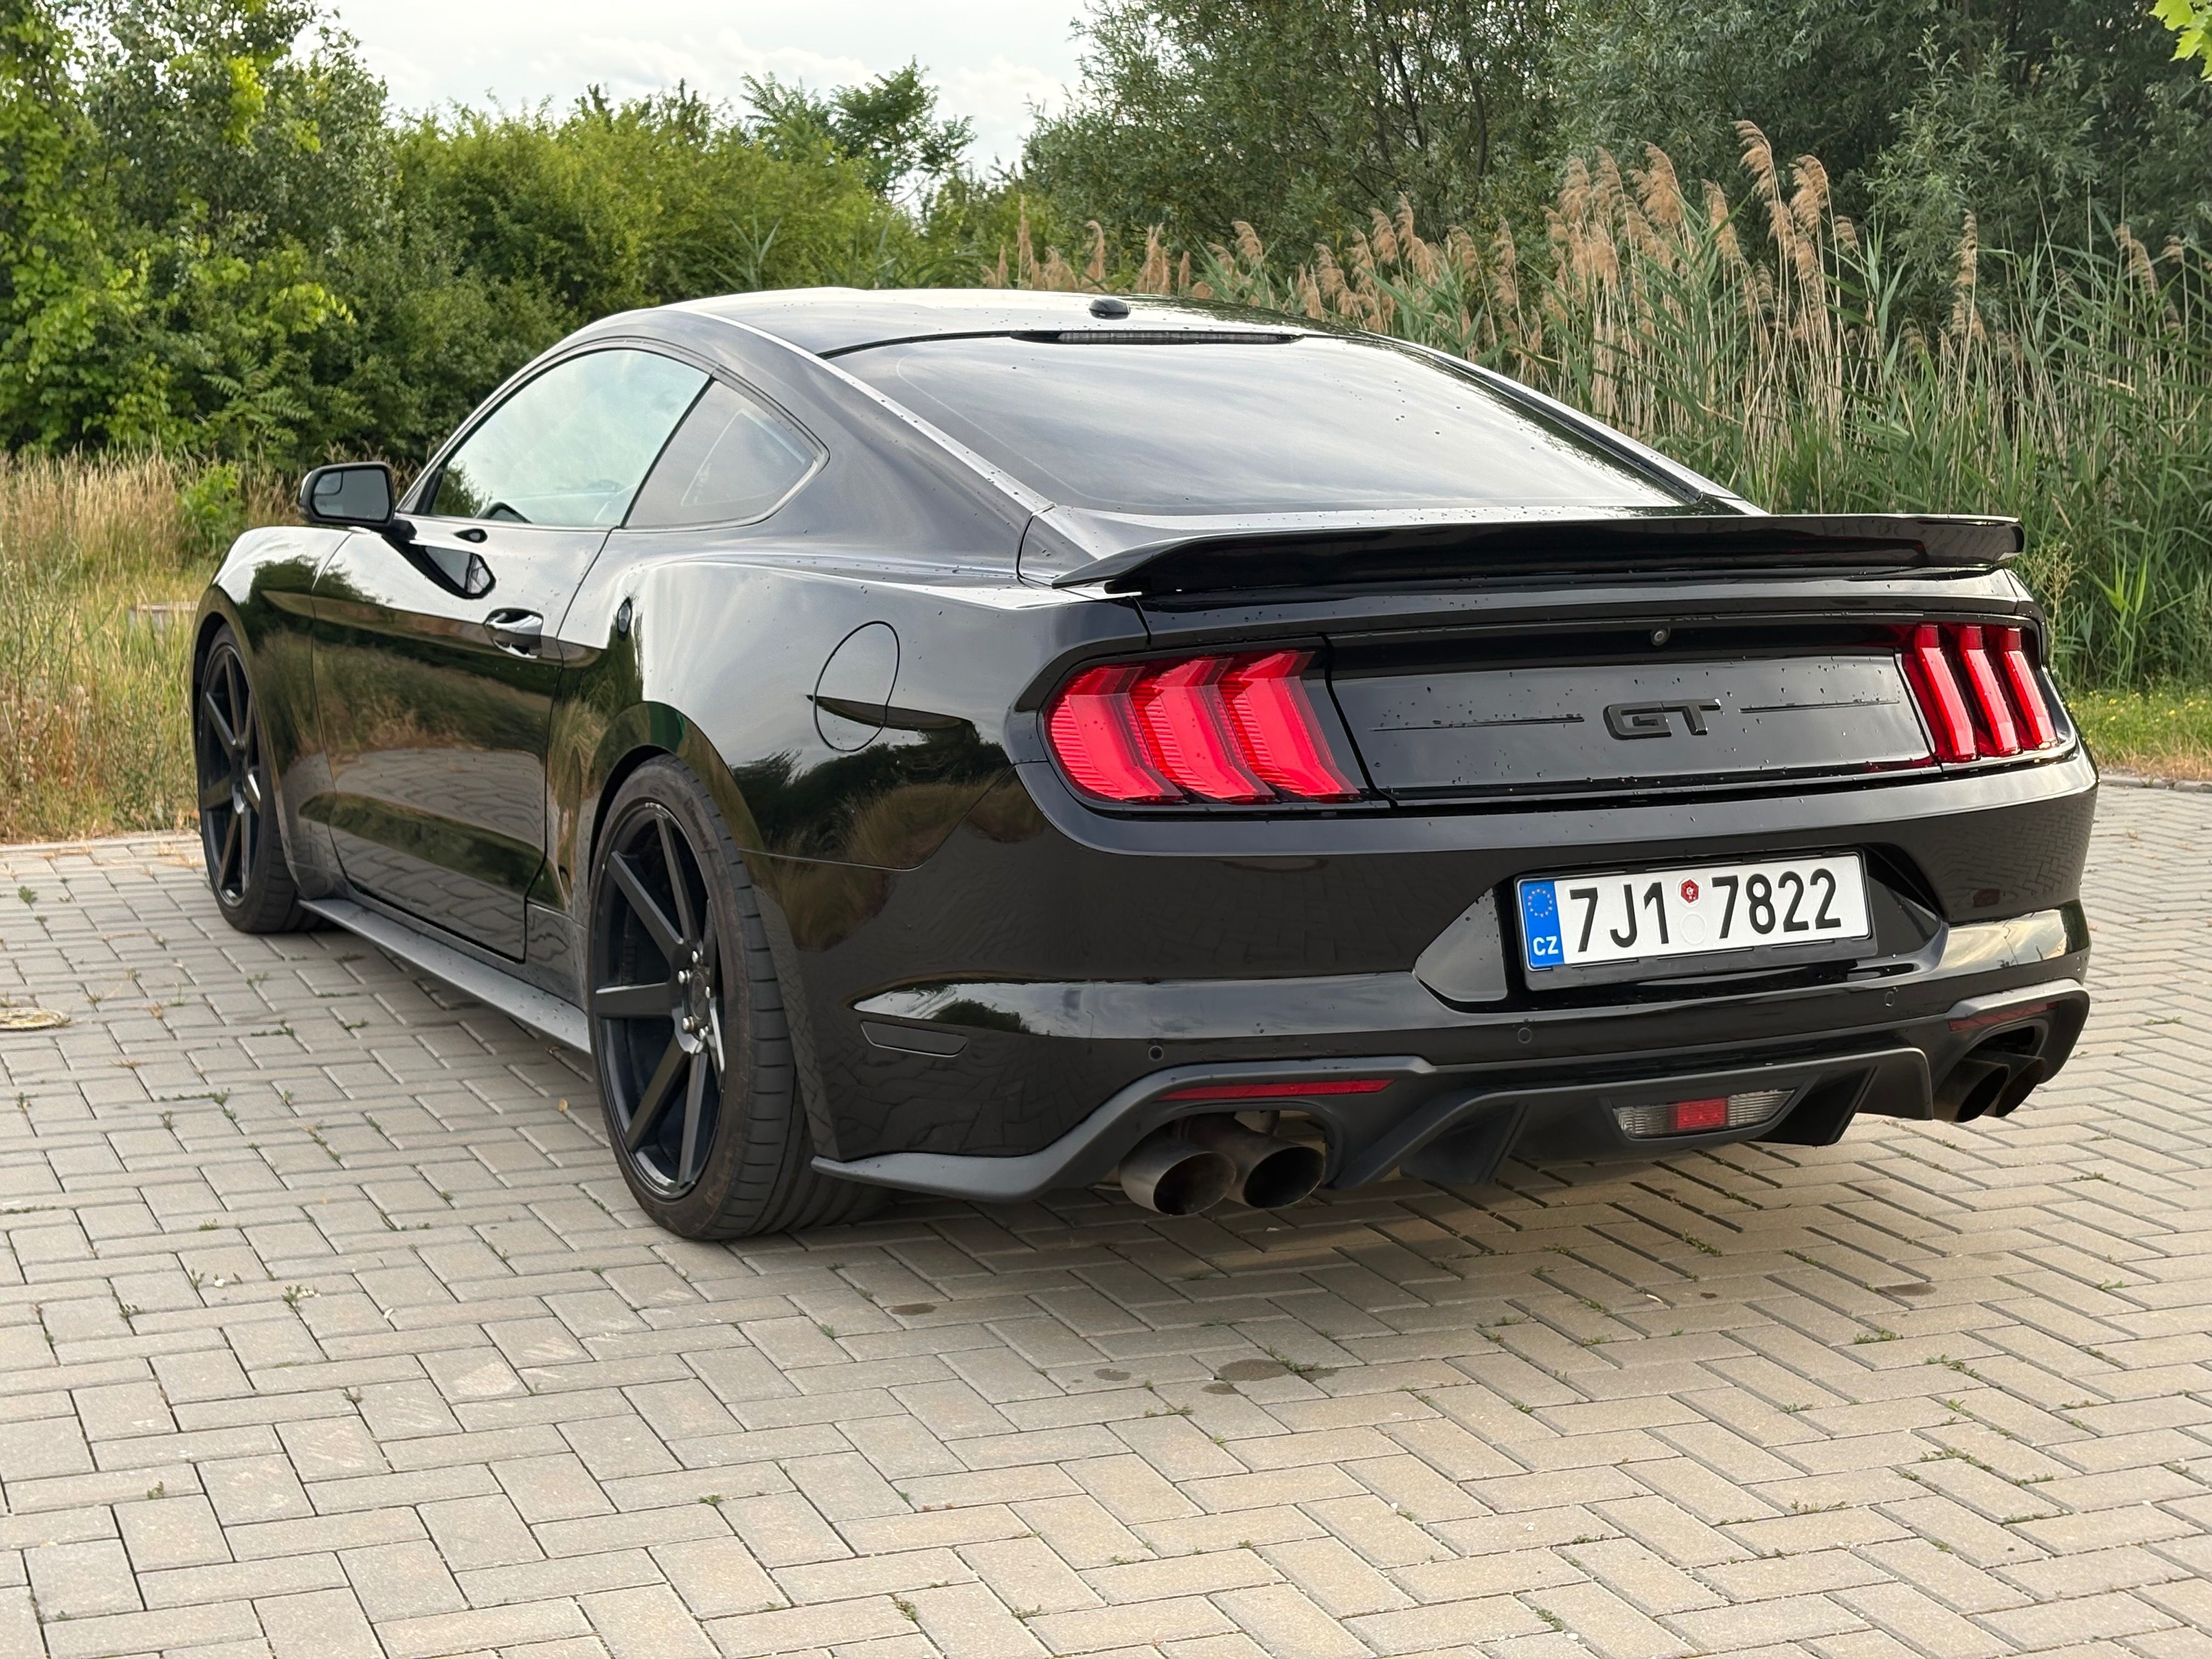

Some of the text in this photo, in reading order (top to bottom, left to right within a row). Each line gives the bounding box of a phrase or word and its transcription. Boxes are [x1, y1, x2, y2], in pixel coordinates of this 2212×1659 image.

[1602, 699, 1721, 740] GT
[1569, 868, 1842, 952] 7J1 7822
[1533, 935, 1559, 956] CZ
